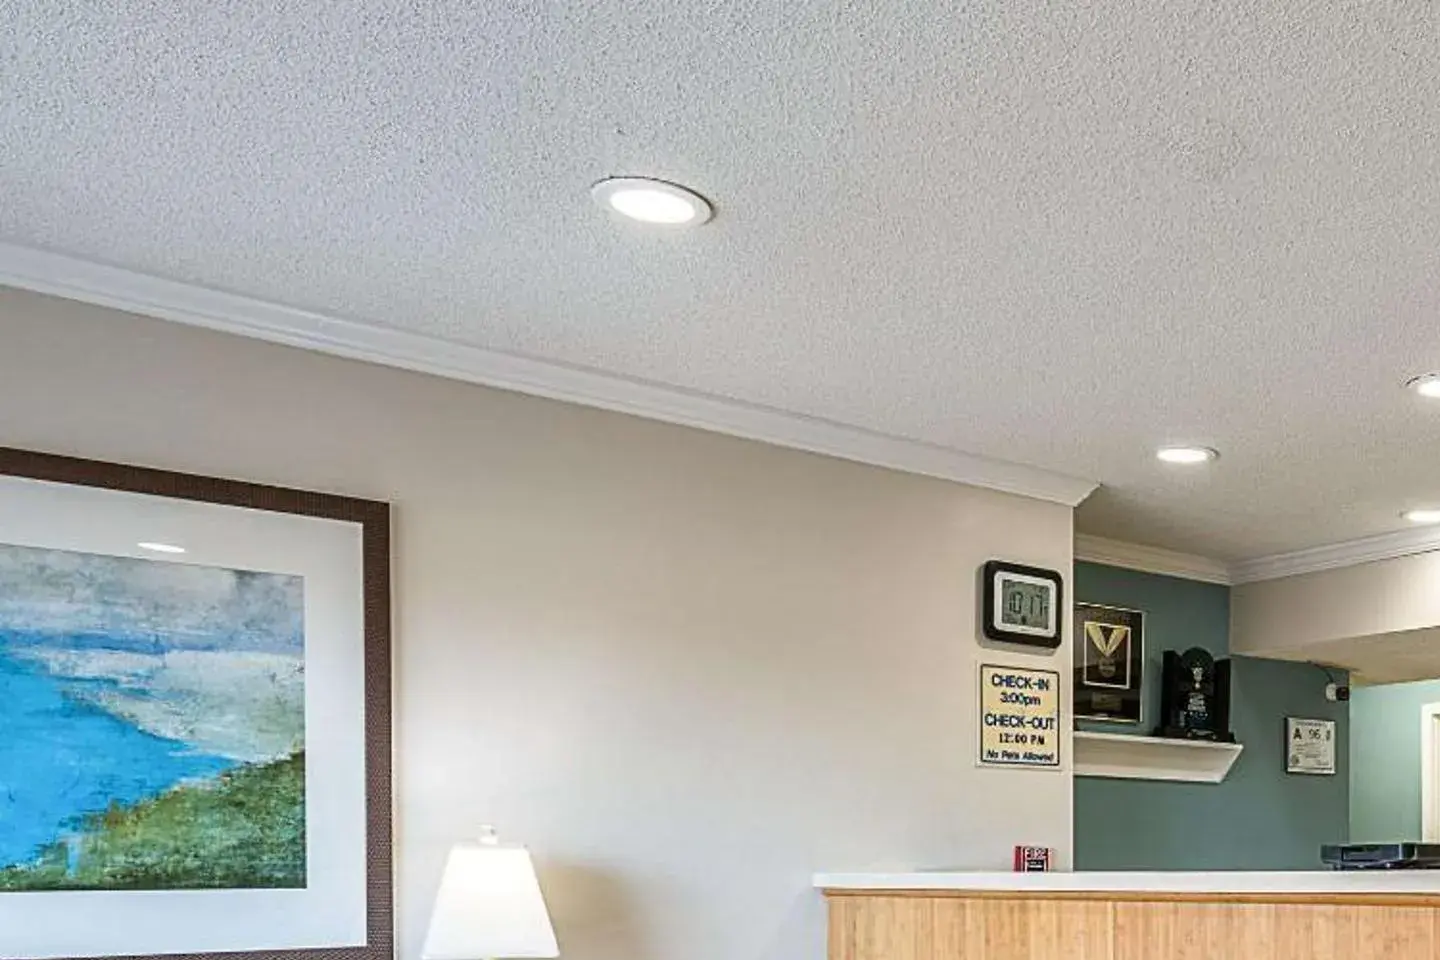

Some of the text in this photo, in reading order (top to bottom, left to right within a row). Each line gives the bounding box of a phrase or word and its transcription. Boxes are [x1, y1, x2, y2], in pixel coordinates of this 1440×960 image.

[992, 673, 1050, 691] CHECK-IN
[984, 713, 1055, 730] CHECK-OUT
[1293, 728, 1302, 740] A
